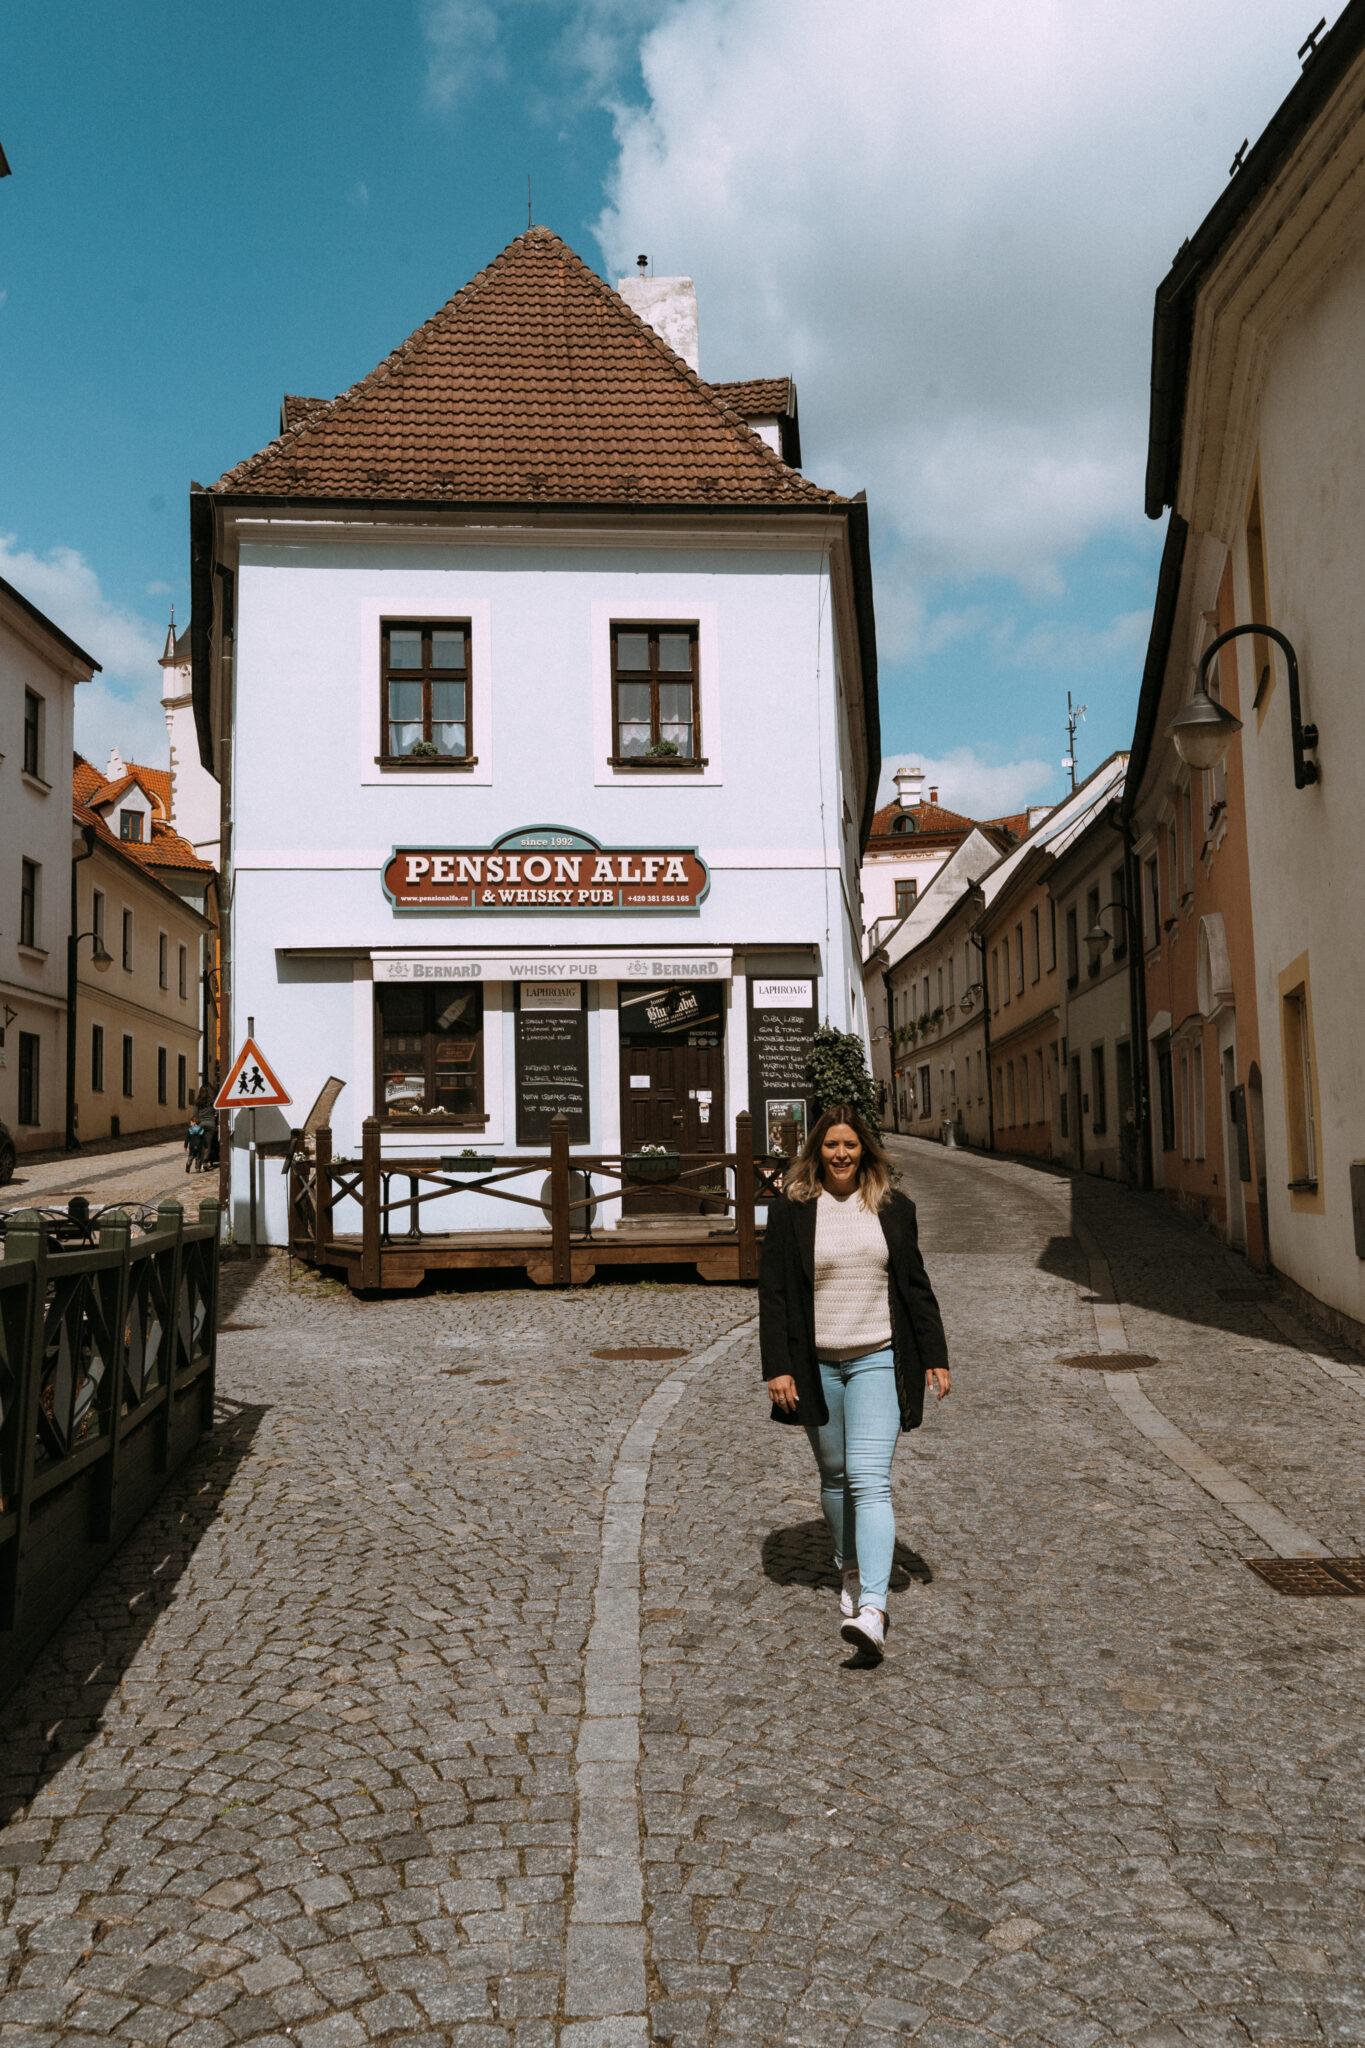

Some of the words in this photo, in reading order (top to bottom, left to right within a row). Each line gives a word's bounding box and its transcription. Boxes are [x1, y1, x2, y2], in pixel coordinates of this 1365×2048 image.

[521, 837, 548, 846] since
[551, 837, 574, 846] 1992
[405, 856, 583, 883] PENSION
[591, 856, 689, 883] ALFA
[482, 889, 496, 903] &
[498, 889, 574, 903] WHISKY
[577, 889, 614, 903] PUB
[413, 963, 482, 977] BERNARD
[509, 964, 566, 976] WHISKY
[569, 964, 599, 975] PUB
[652, 961, 719, 976] BERNARD
[526, 987, 576, 997] LAPHROAIG
[759, 985, 808, 995] LAPHROAIG
